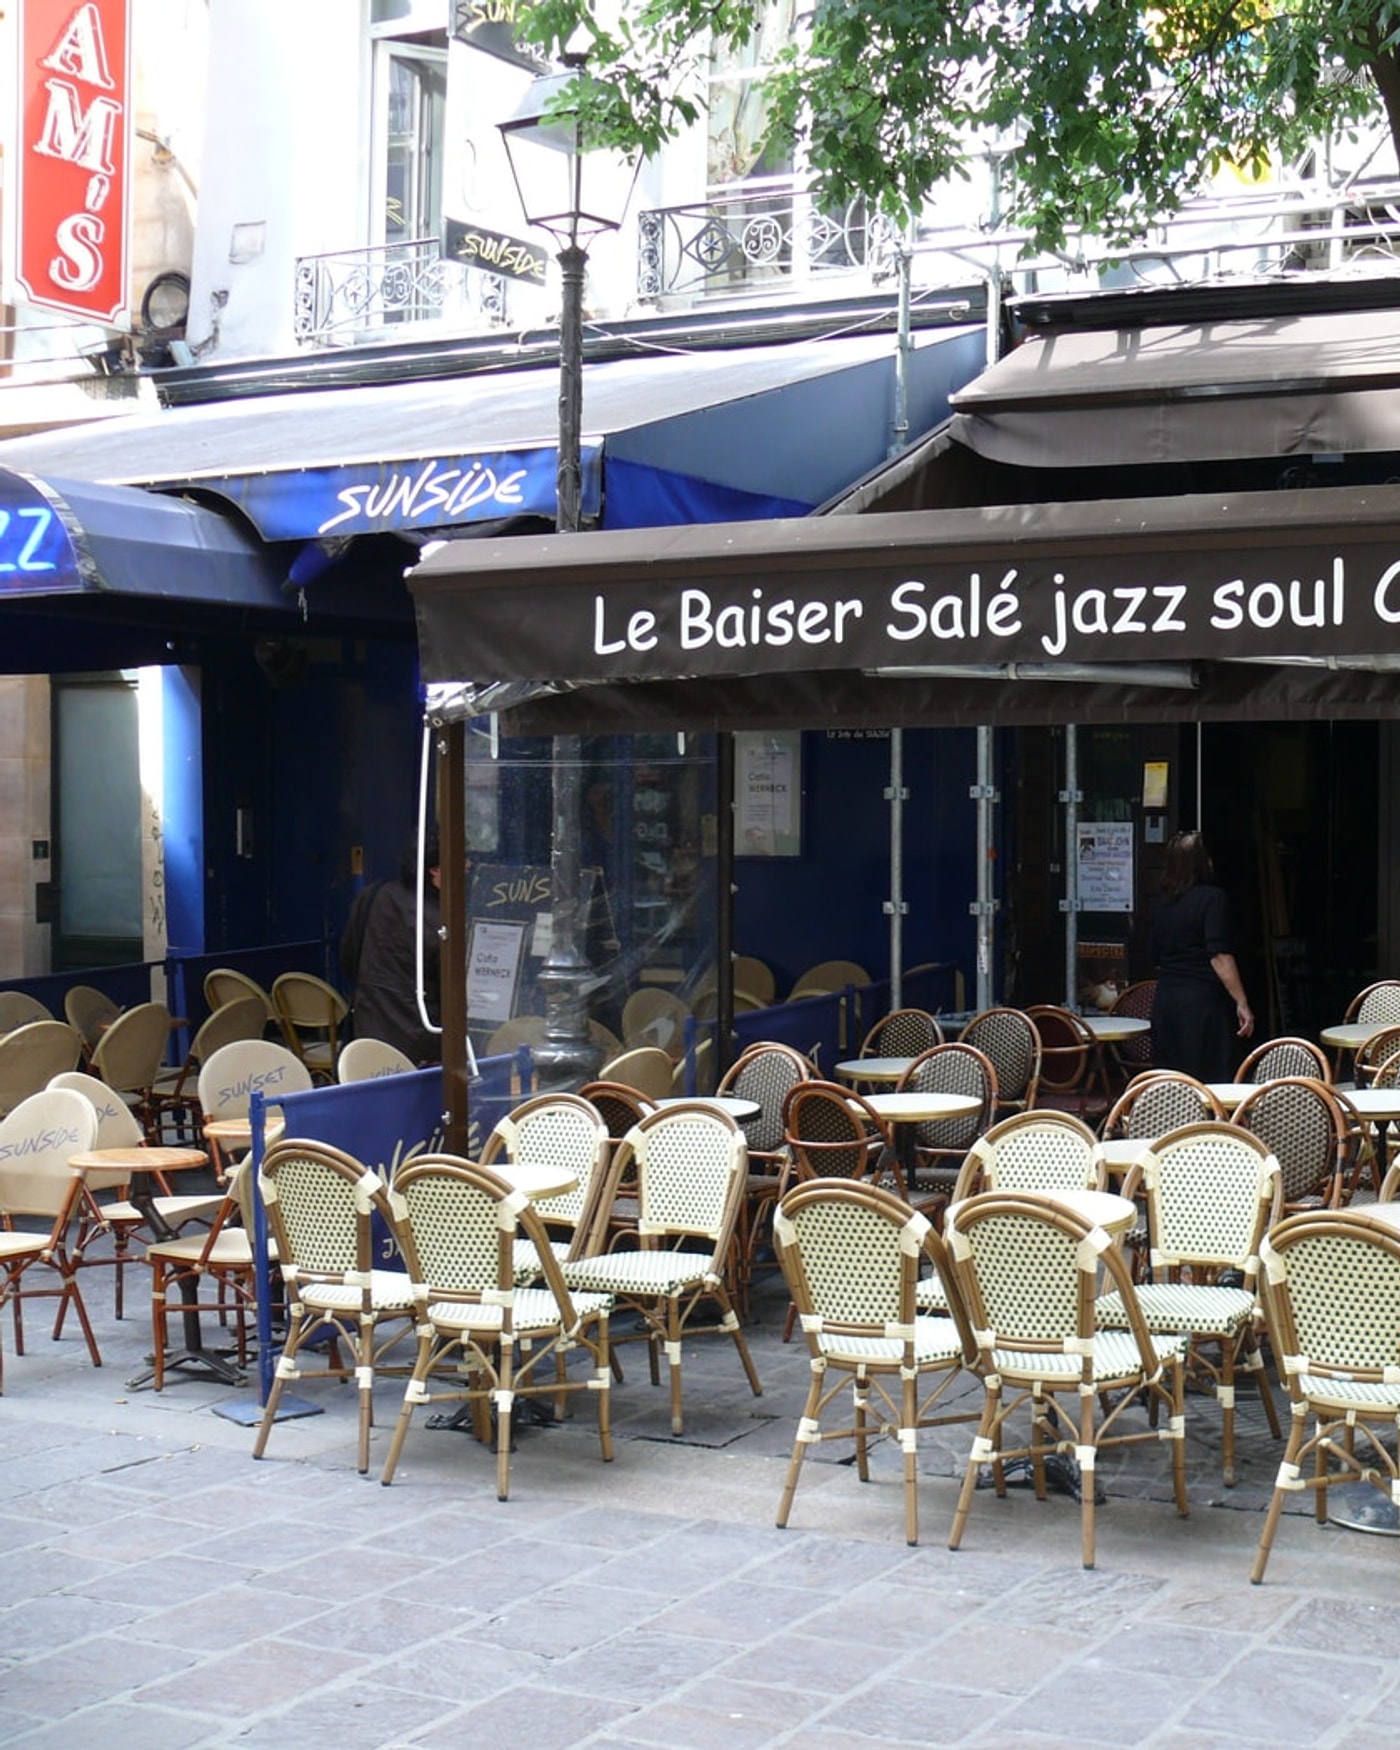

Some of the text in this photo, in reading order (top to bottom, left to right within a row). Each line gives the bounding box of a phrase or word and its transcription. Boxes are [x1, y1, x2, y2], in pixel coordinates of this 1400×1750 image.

[457, 233, 547, 279] SUNSIDE
[317, 461, 528, 535] SUNSIDE
[594, 595, 659, 656] Le
[679, 588, 864, 651] Baiser
[885, 568, 1023, 641] Salé
[1041, 573, 1188, 657] jazz
[1210, 556, 1345, 630] soul
[217, 1065, 287, 1107] SUNSET
[0, 1126, 79, 1161] SUNSIDE
